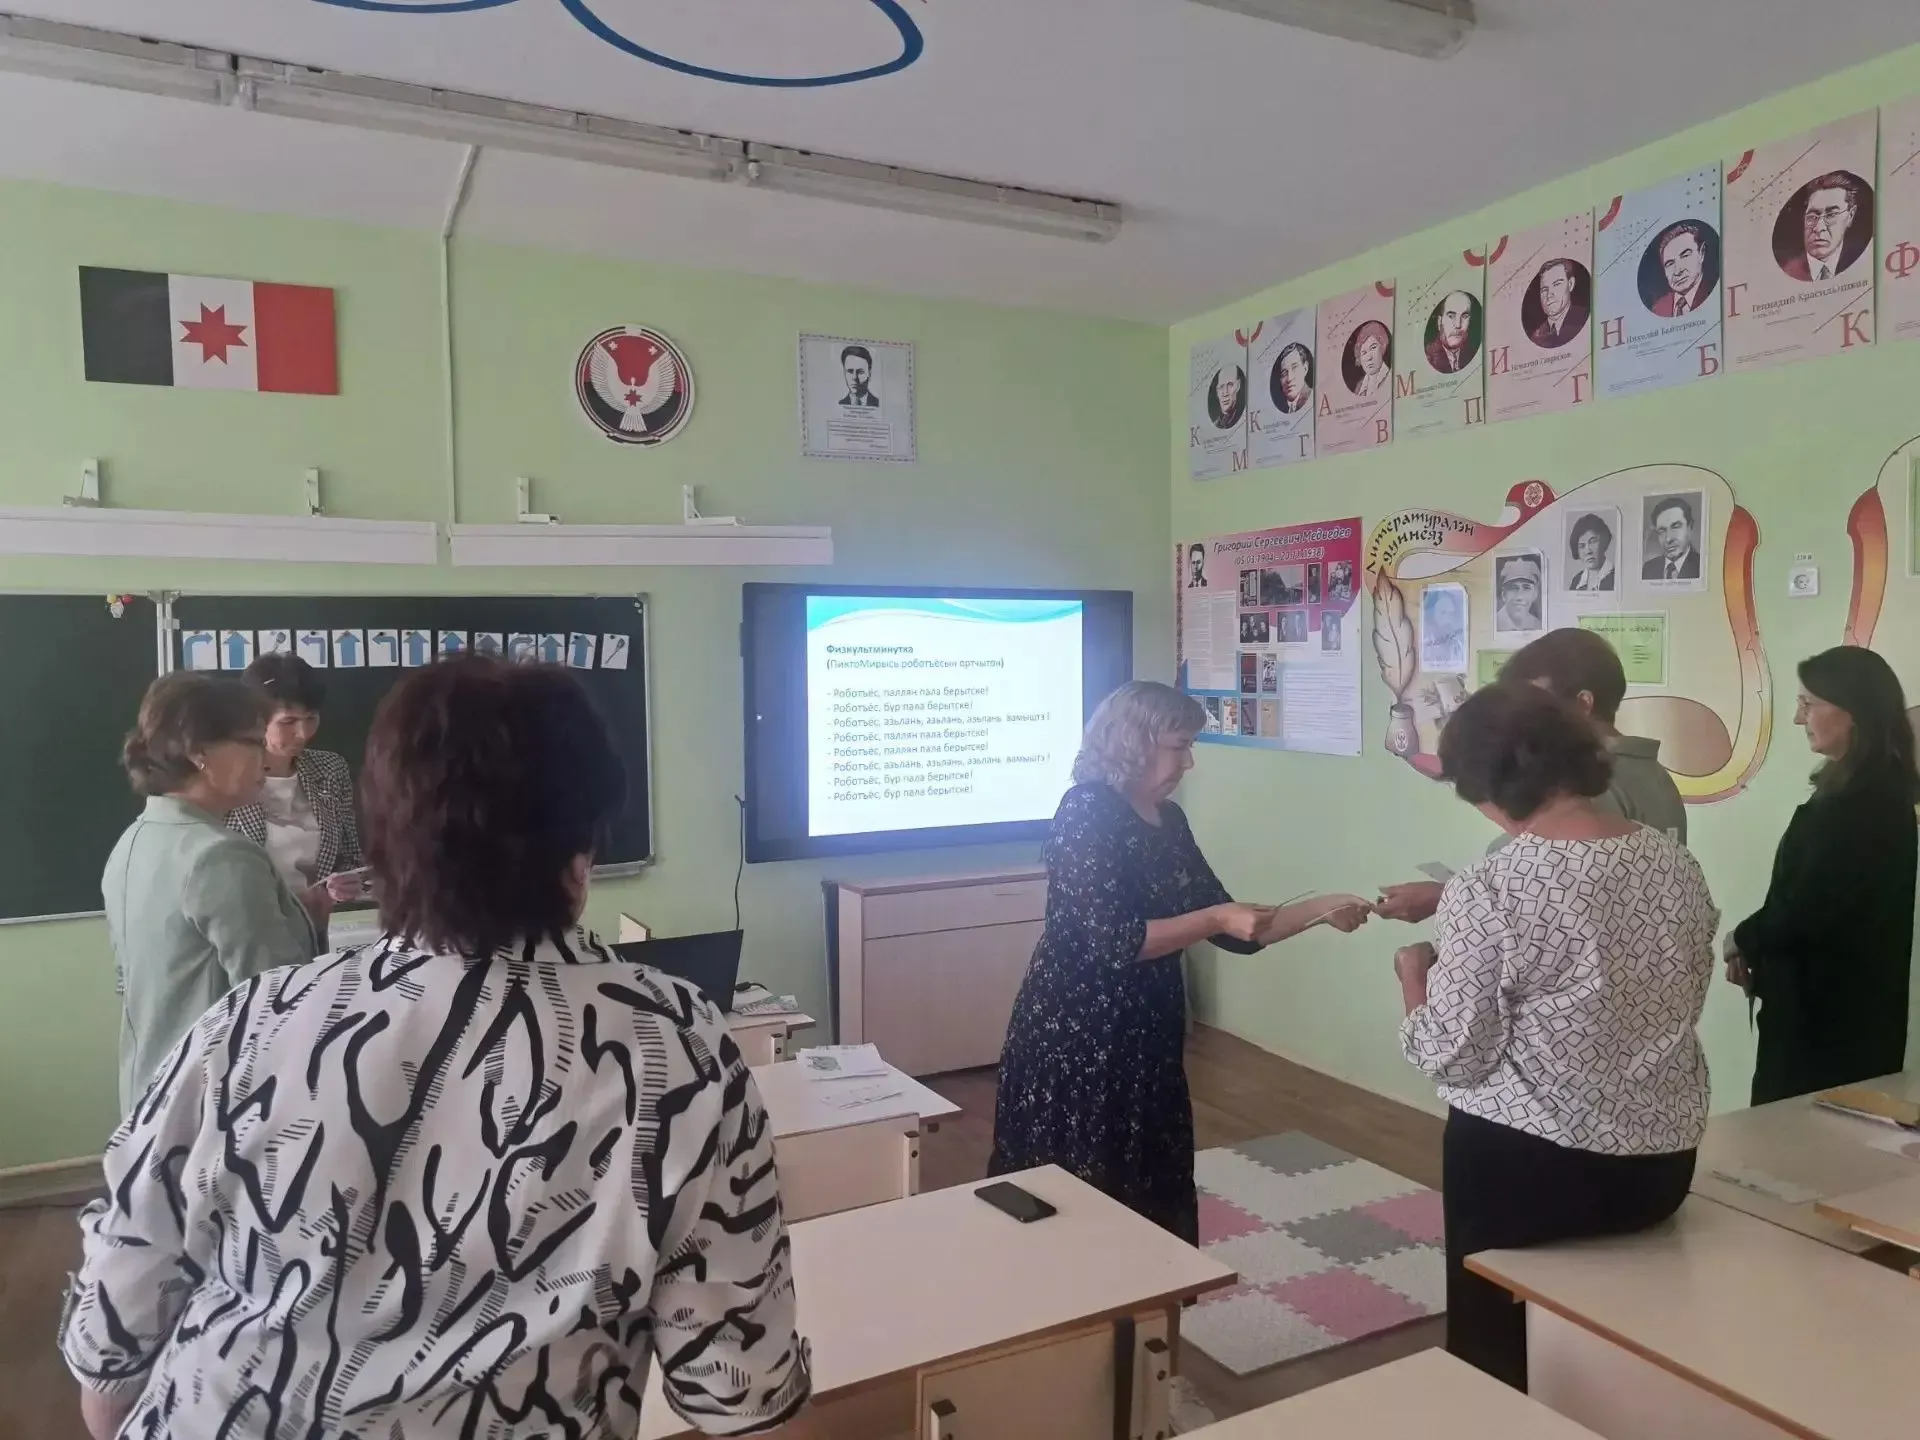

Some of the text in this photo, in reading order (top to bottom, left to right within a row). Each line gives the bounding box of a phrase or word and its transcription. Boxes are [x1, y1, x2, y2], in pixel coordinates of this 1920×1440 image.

[1885, 241, 1920, 280] Ф
[1727, 282, 1748, 318] Г
[1752, 295, 1795, 312] Геннадий
[1600, 316, 1625, 350] Н
[1839, 308, 1871, 348] К
[1489, 345, 1510, 376] И
[1697, 343, 1719, 376] Б
[1396, 370, 1416, 399] М
[1572, 373, 1588, 403] Г
[1319, 394, 1332, 417] А
[1464, 396, 1482, 424] П
[1249, 410, 1262, 432] К
[1375, 420, 1388, 443] В
[1190, 425, 1200, 447] К
[1298, 433, 1309, 457] Г
[1232, 449, 1248, 472] М
[1213, 526, 1351, 552] Григорий Сергеевич Медведев
[826, 645, 914, 656] Физкультминутка
[884, 688, 917, 697] паллян
[919, 687, 941, 696] пала
[943, 685, 988, 697] берытске!
[884, 702, 901, 712] бур
[903, 703, 925, 711] пала
[927, 700, 973, 711] берытске!
[884, 732, 917, 741] паллян
[920, 731, 941, 739] пала
[943, 728, 989, 739] берытске!
[884, 746, 917, 755] паллян
[920, 744, 941, 753] пала
[943, 741, 989, 752] берытске!
[884, 774, 901, 785] бур
[903, 773, 925, 783] пала
[927, 770, 973, 781] берытске!
[884, 788, 901, 799] бур
[903, 787, 925, 797] пала
[927, 784, 973, 796] берытске!
